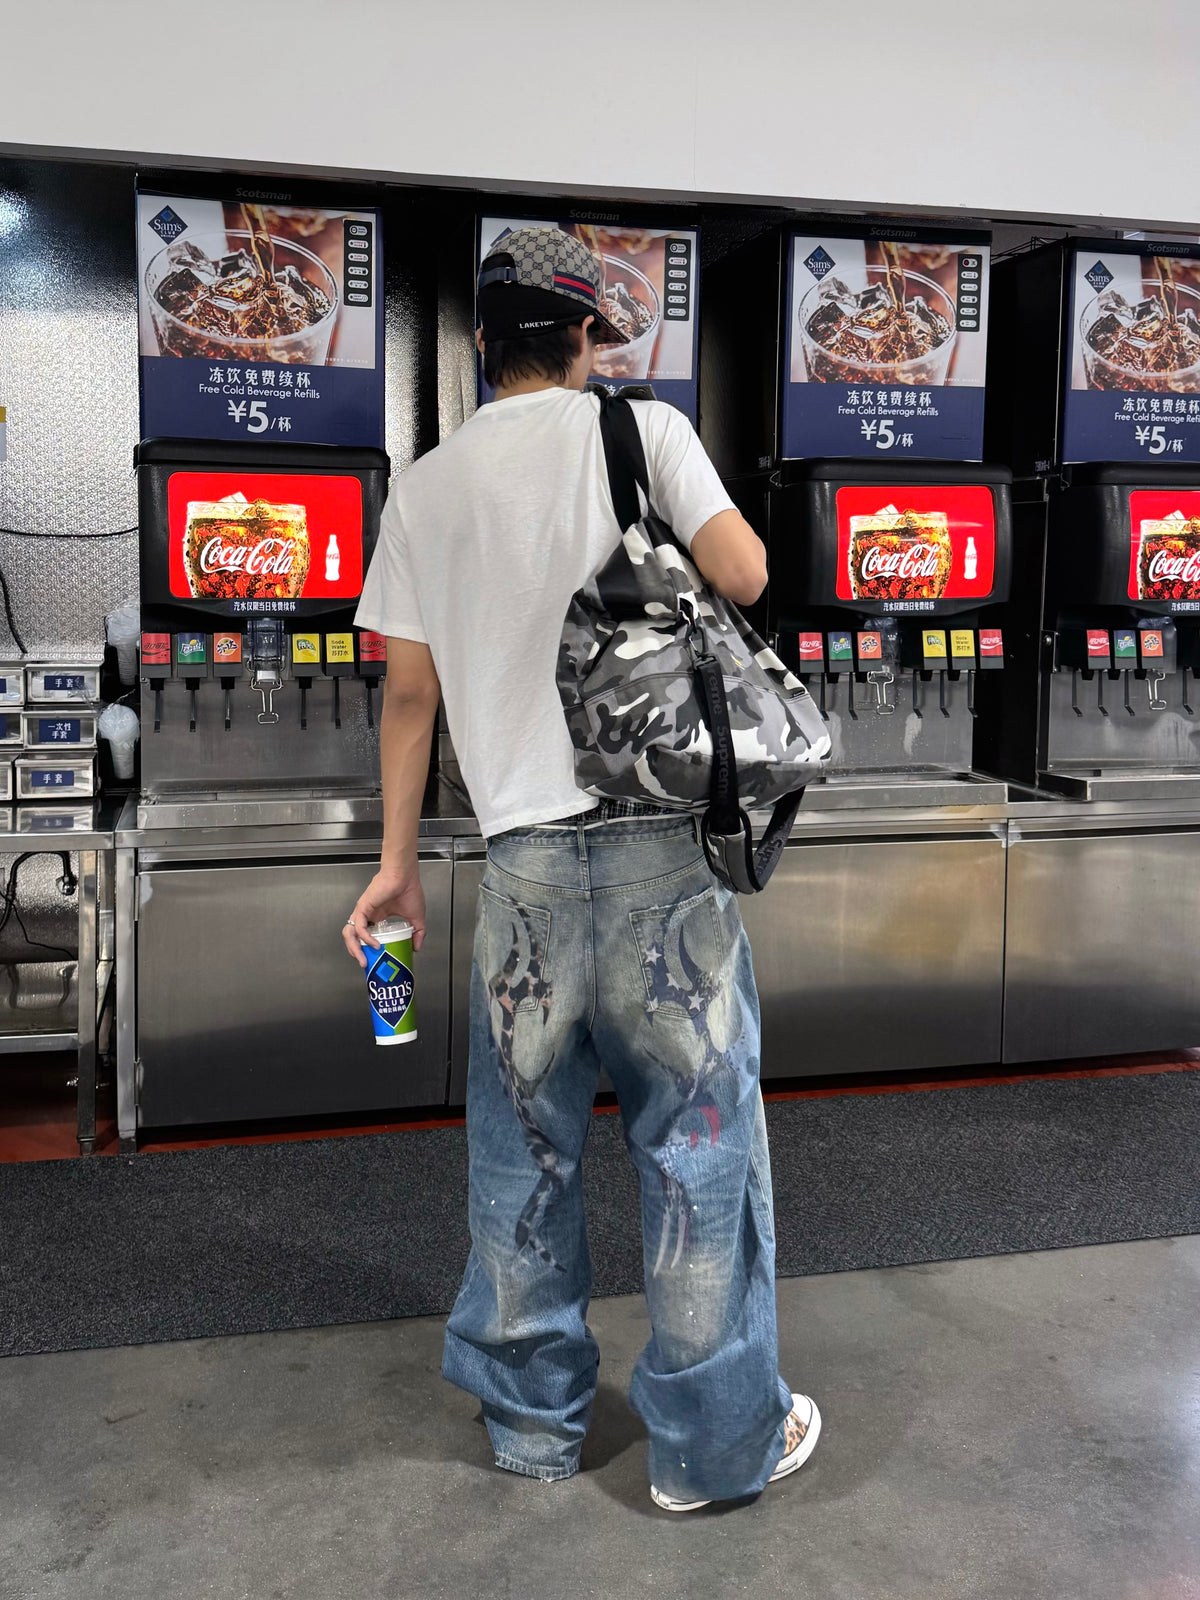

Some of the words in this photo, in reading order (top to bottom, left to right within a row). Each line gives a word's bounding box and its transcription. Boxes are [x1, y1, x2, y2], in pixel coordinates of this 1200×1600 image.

[235, 187, 293, 201] Scotsman
[569, 209, 620, 221] Scotsman
[153, 219, 182, 231] Sam's
[870, 227, 917, 238] Scotsman
[1147, 243, 1190, 254] Scotsman
[808, 257, 832, 269] Sam's
[209, 366, 311, 389] 冻饮免费续杯
[199, 383, 220, 394] Free
[222, 384, 245, 395] Cold
[247, 386, 291, 400] Beverage
[294, 388, 320, 399] Refills
[847, 390, 932, 407] 冻饮免费续杯
[838, 405, 856, 415] Free
[857, 405, 876, 415] Cold
[877, 406, 915, 418] Beverage
[916, 407, 939, 417] Refills
[1122, 397, 1200, 414] 冻饮免费续杯
[1114, 411, 1131, 421] Free
[1132, 412, 1150, 421] Cold
[1150, 413, 1185, 425] Beverage
[200, 537, 296, 575] Coca-Cola
[861, 543, 940, 580] Coca-Cola
[47, 722, 71, 731] 一次性
[52, 730, 67, 739] 手套
[43, 773, 63, 784] 手套
[369, 980, 412, 1001] Sam's
[378, 998, 405, 1007] CLUB
